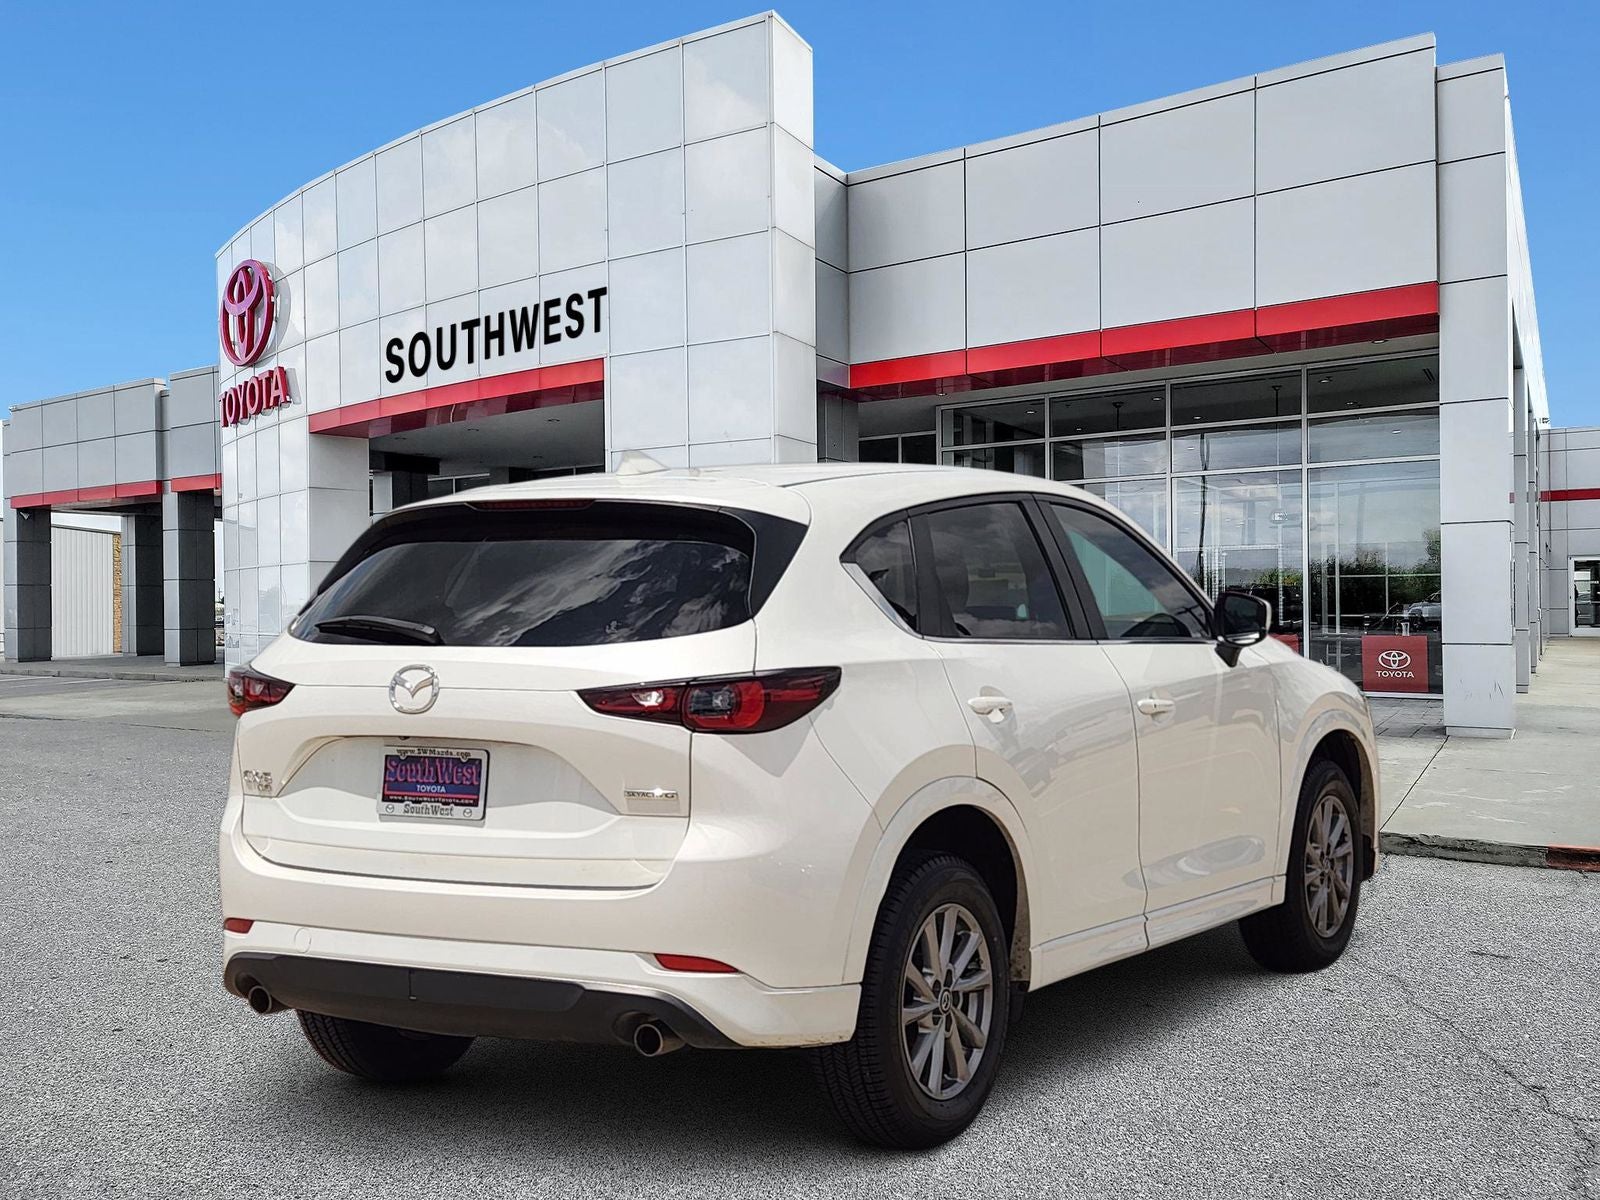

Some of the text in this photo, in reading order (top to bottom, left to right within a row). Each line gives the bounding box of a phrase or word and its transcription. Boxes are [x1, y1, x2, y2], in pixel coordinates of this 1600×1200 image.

[385, 286, 608, 384] SOUTHWEST
[218, 366, 292, 428] TOYOTA
[1375, 670, 1415, 678] TOYOTA
[403, 804, 454, 816] SouthWest
